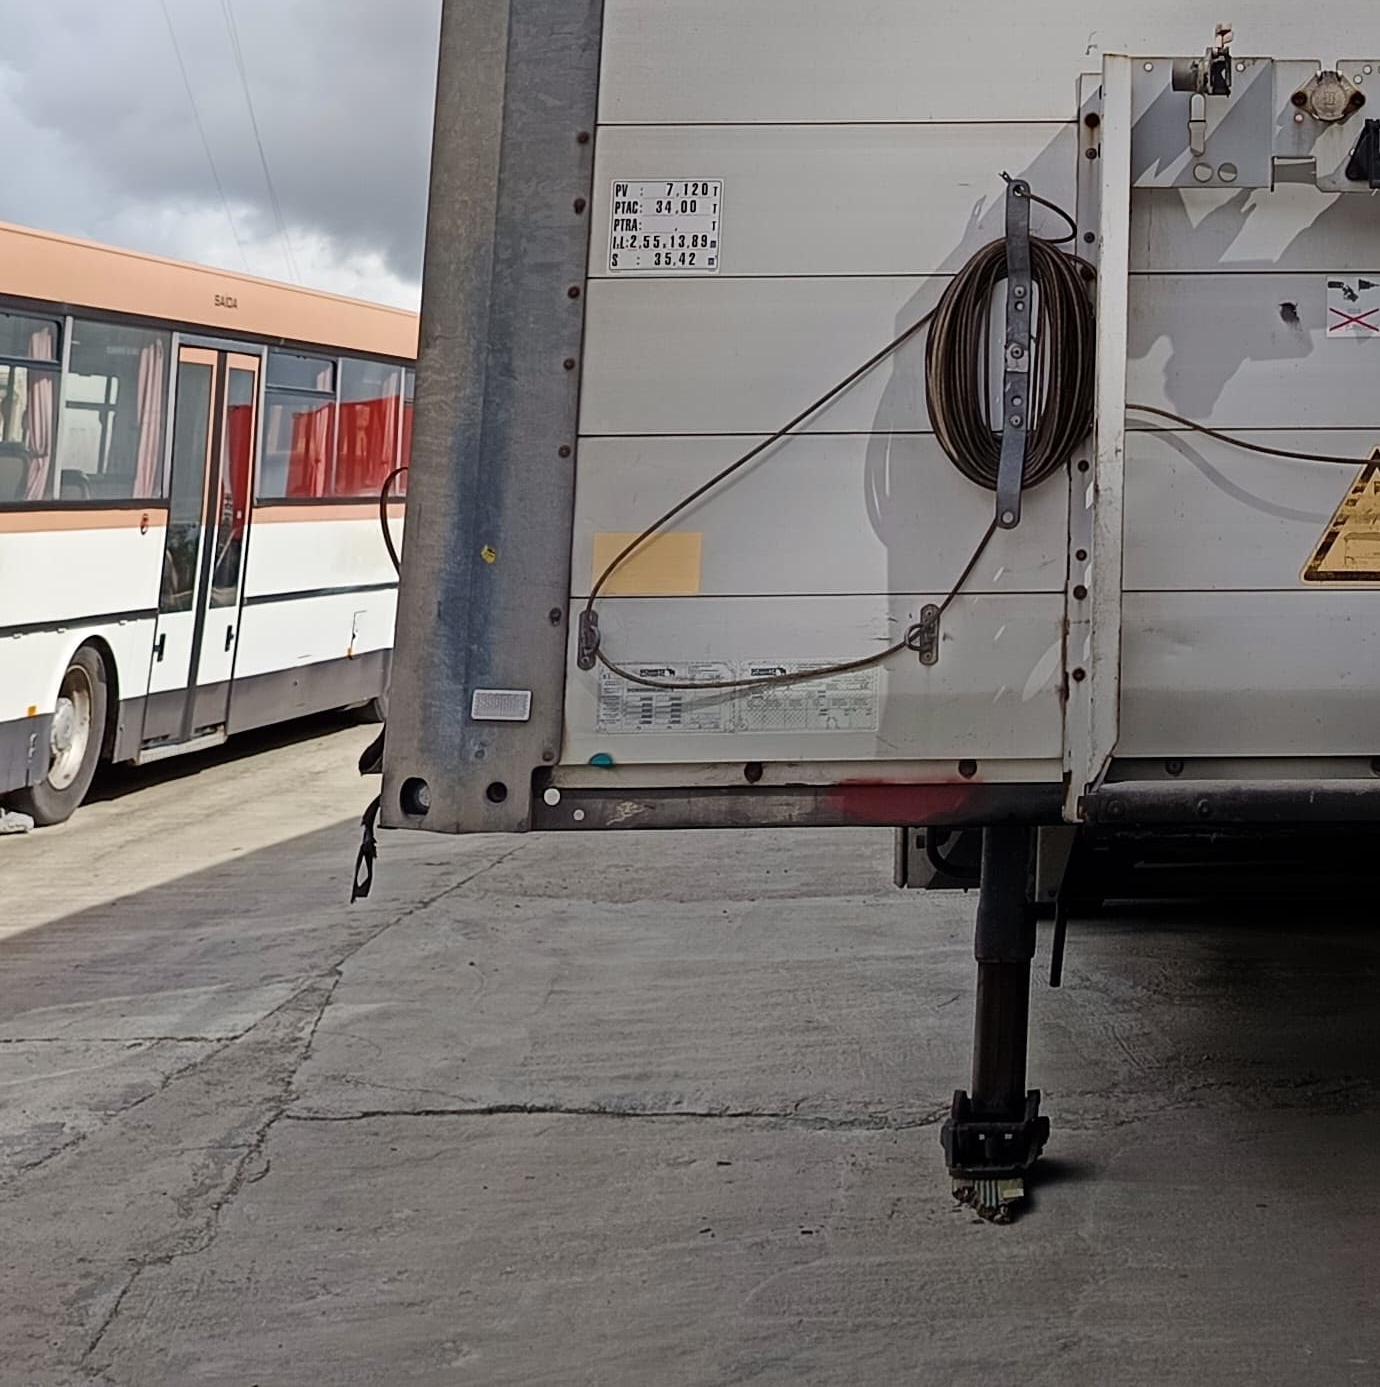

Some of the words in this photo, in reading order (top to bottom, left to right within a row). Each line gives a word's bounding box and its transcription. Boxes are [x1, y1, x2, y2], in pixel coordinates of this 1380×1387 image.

[615, 184, 629, 197] PV
[713, 186, 718, 197] T
[712, 203, 718, 214] T
